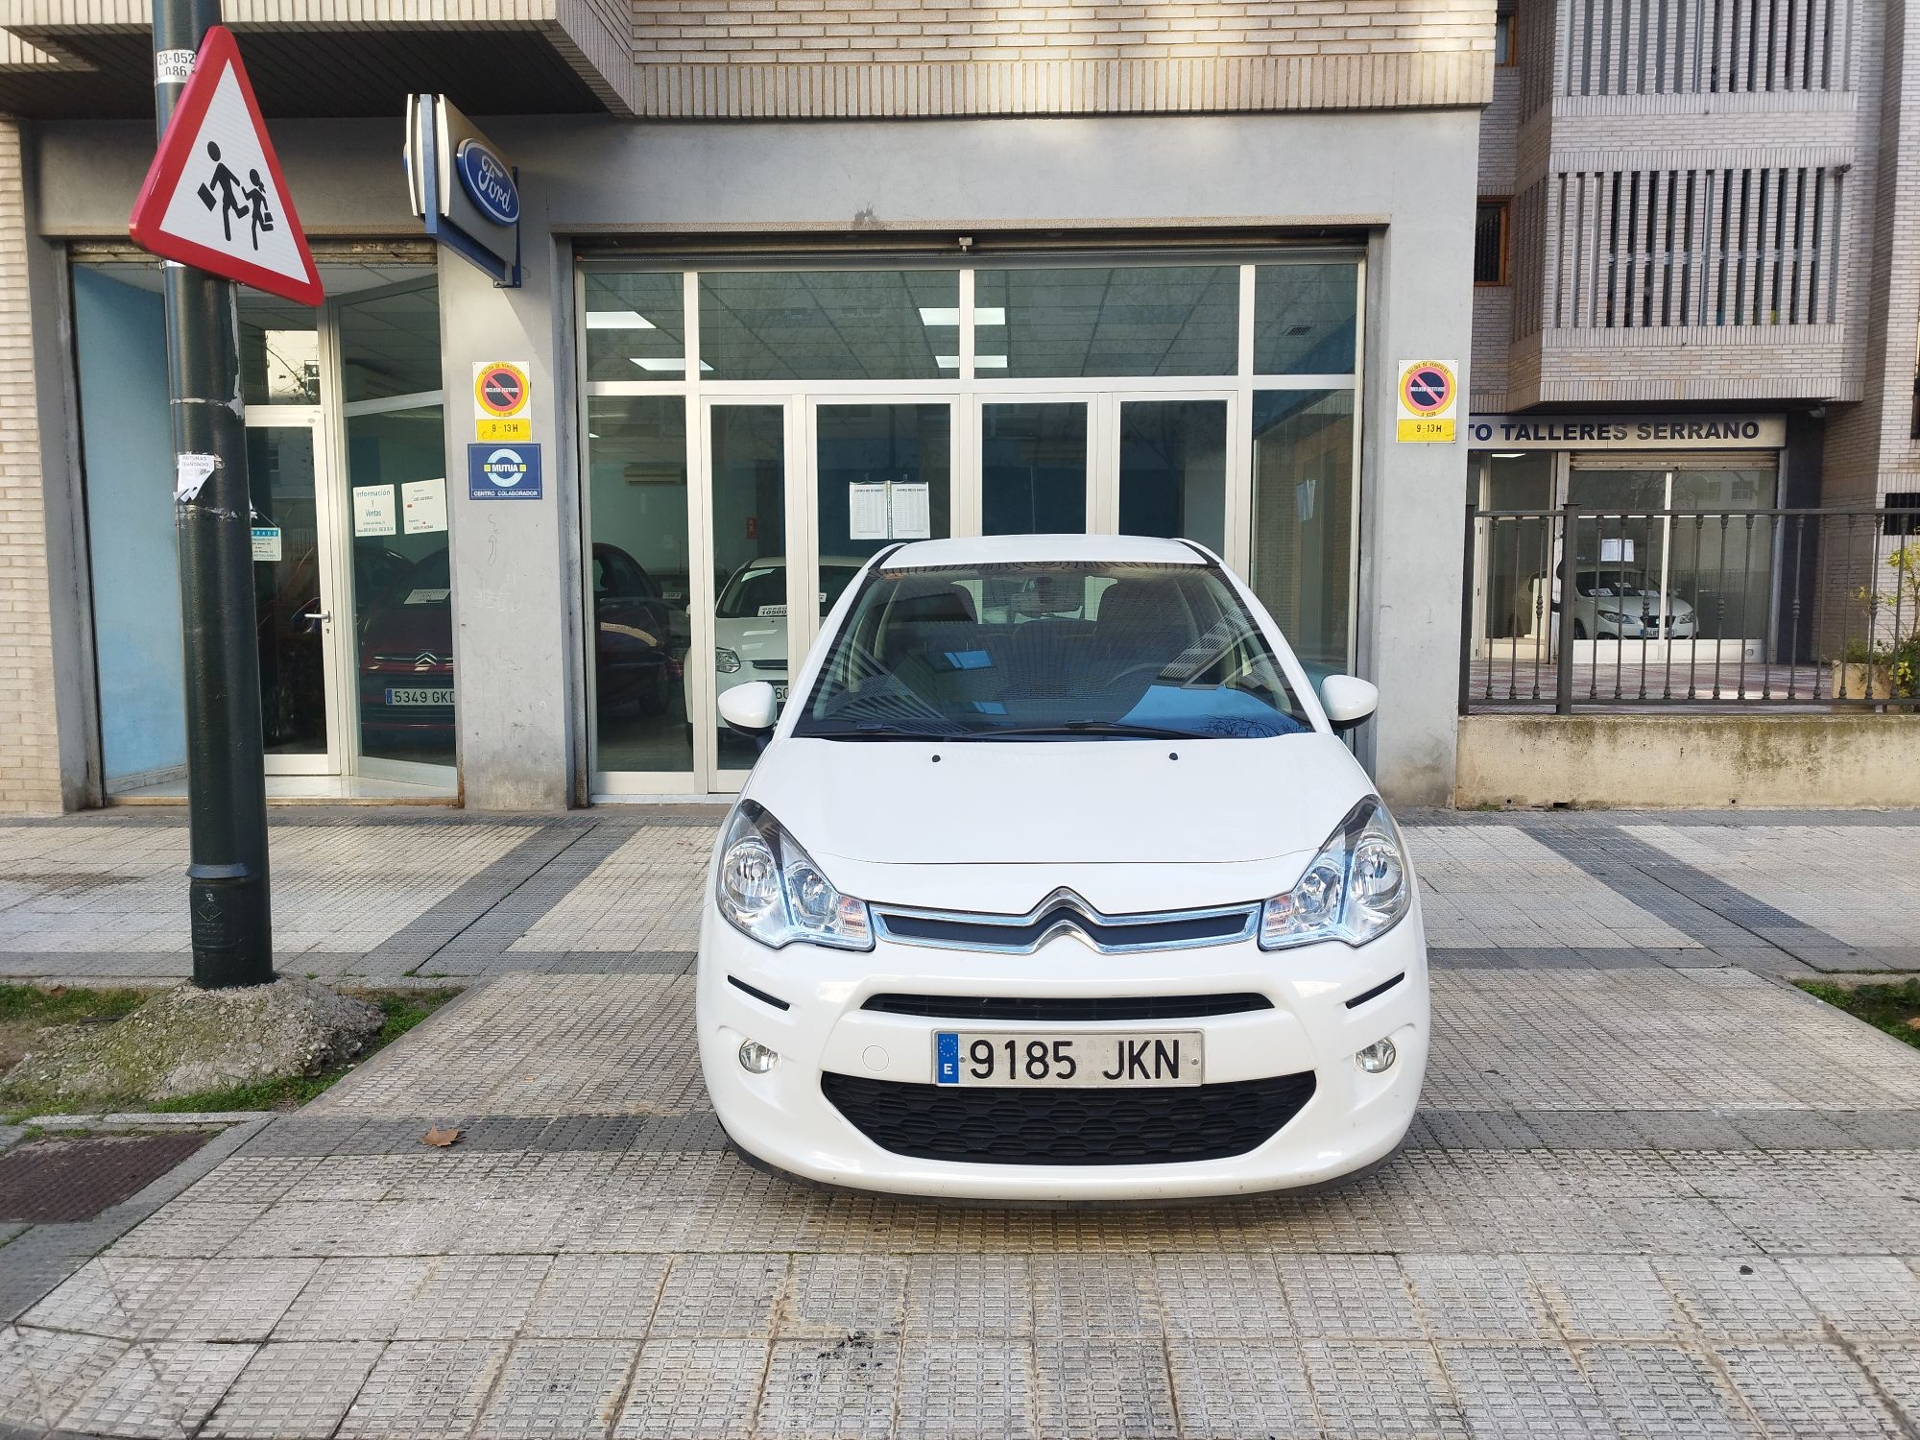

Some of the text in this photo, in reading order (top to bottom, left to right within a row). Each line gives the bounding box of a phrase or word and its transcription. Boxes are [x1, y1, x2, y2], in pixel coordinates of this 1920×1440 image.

[478, 155, 511, 212] Ford
[1500, 422, 1628, 441] TALLERES
[1636, 421, 1760, 441] SERRANO
[491, 464, 519, 473] MUTUA
[394, 690, 428, 703] 5349
[943, 1039, 1180, 1080] E 9185 JKN
